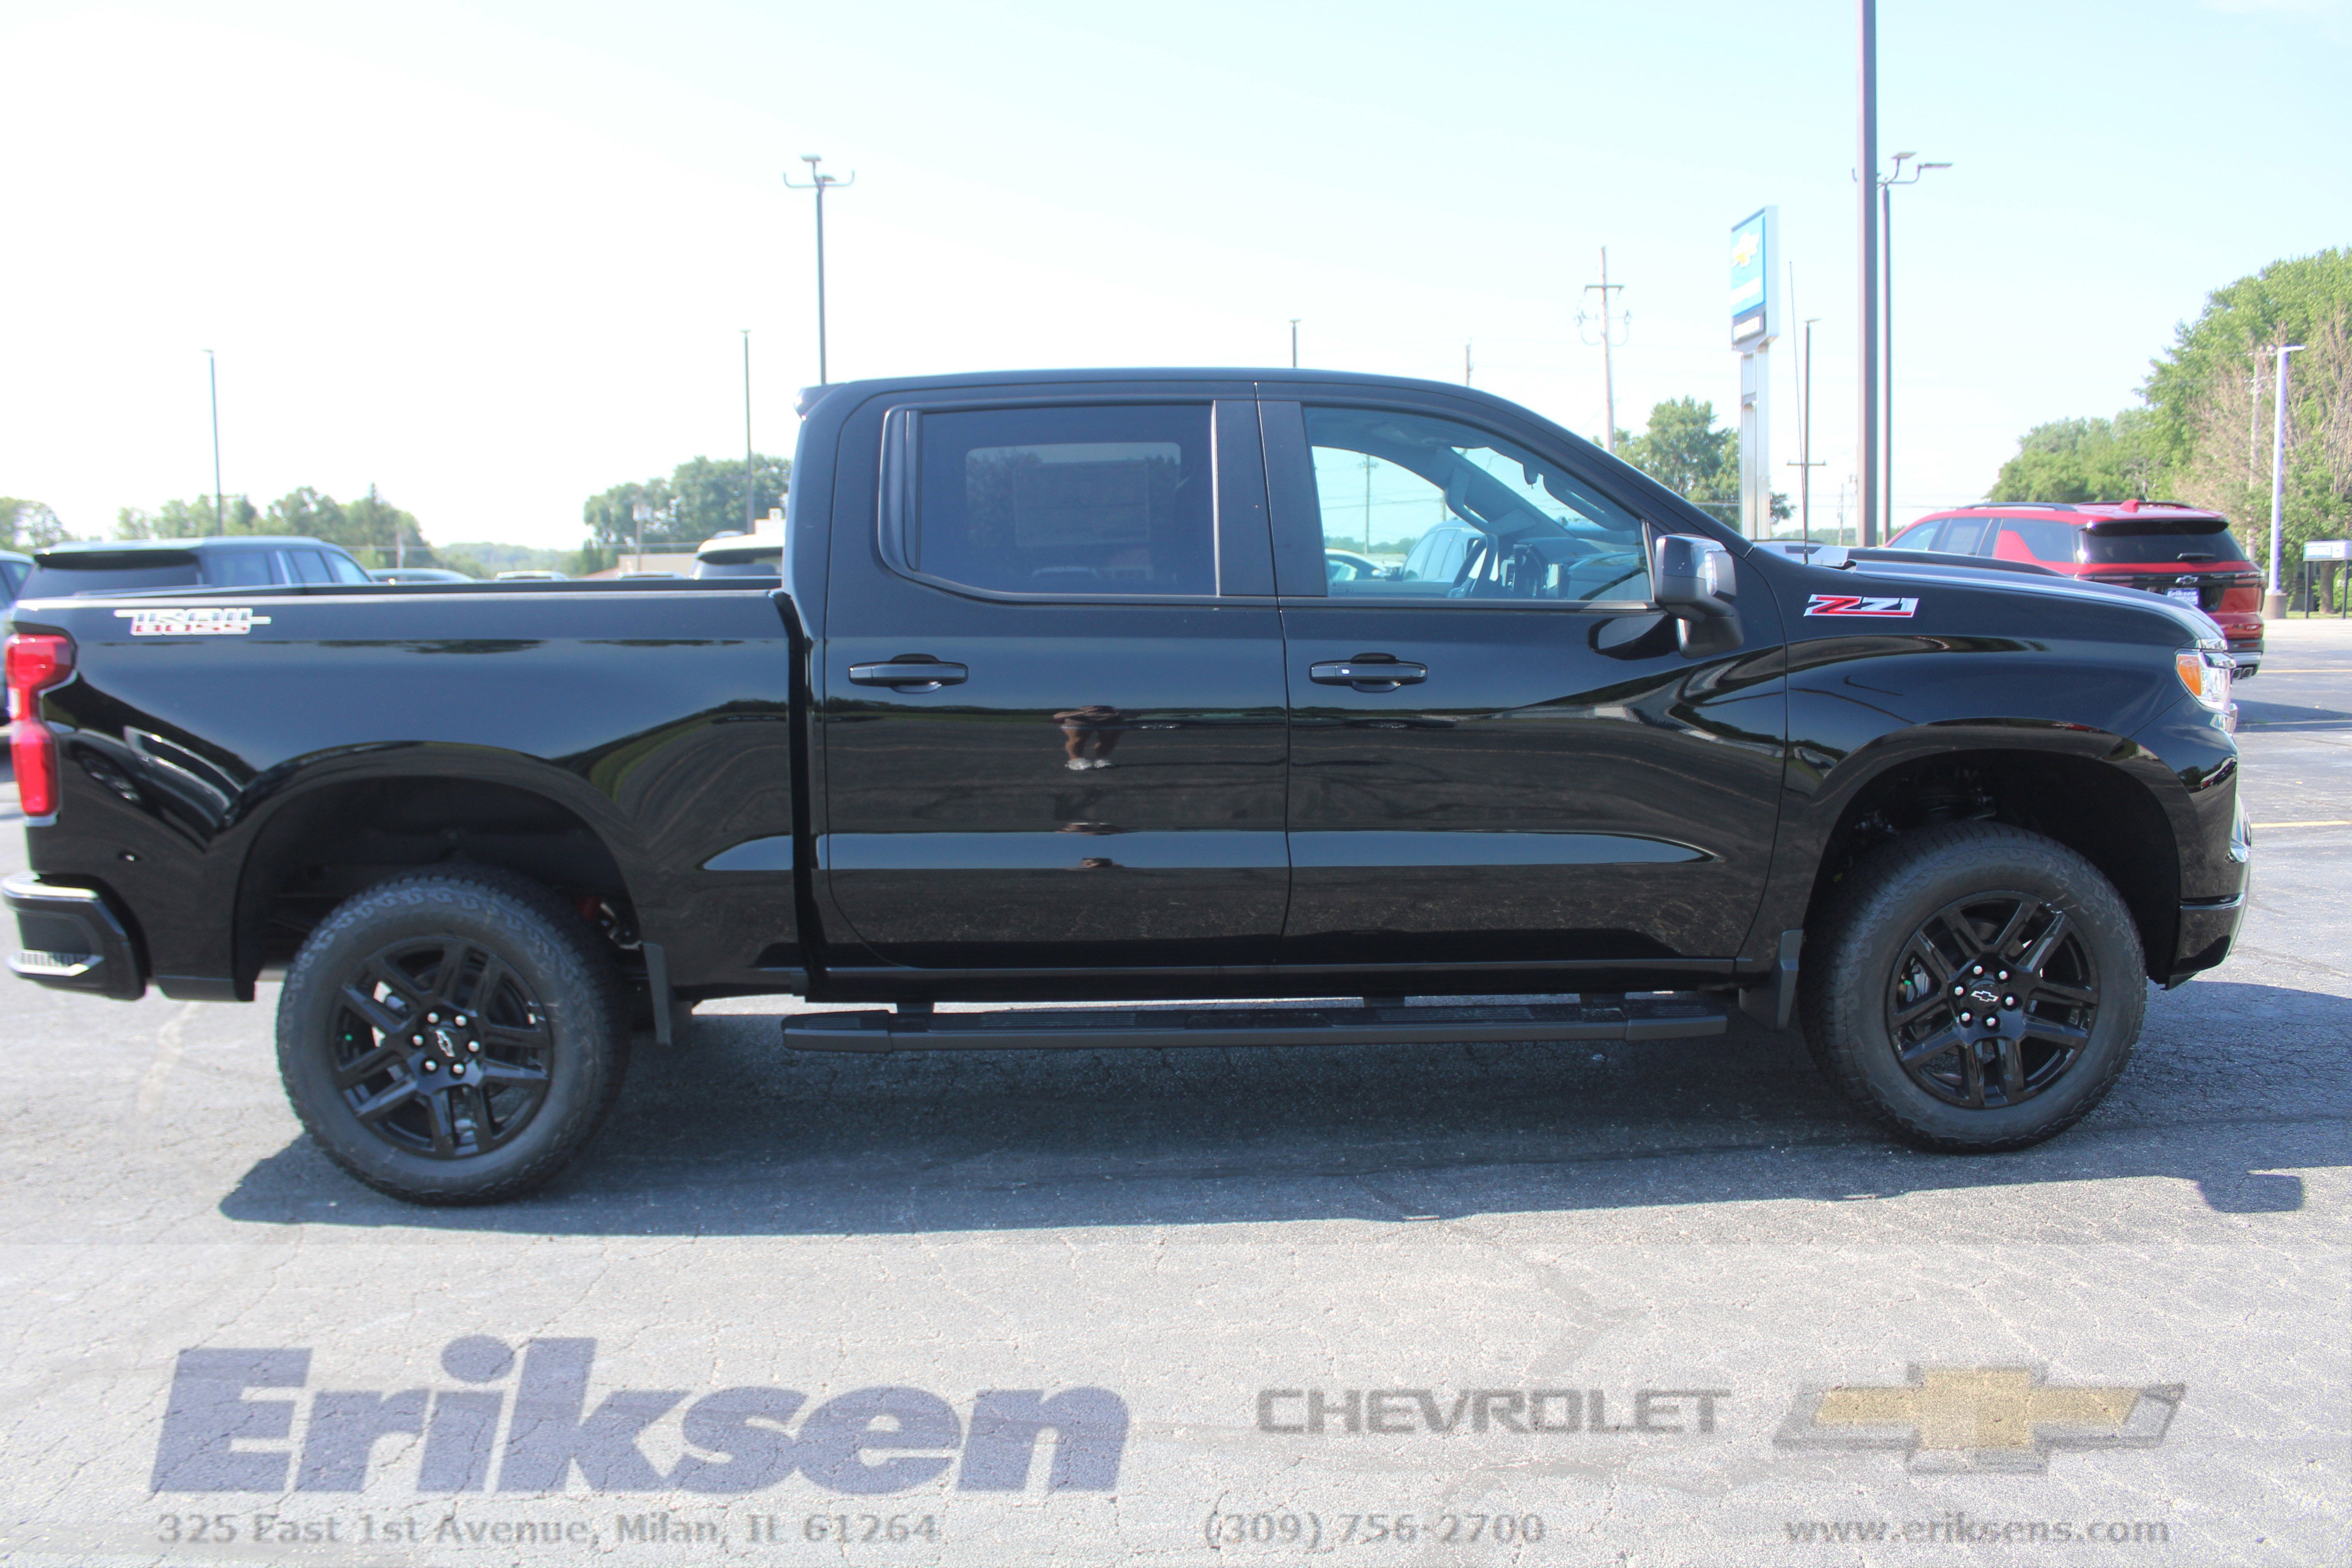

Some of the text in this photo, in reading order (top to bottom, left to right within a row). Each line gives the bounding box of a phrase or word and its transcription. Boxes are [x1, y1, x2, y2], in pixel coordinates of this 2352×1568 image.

[1803, 594, 1919, 617] Z71
[114, 608, 272, 624] TRAIL
[130, 622, 251, 636] BOSS
